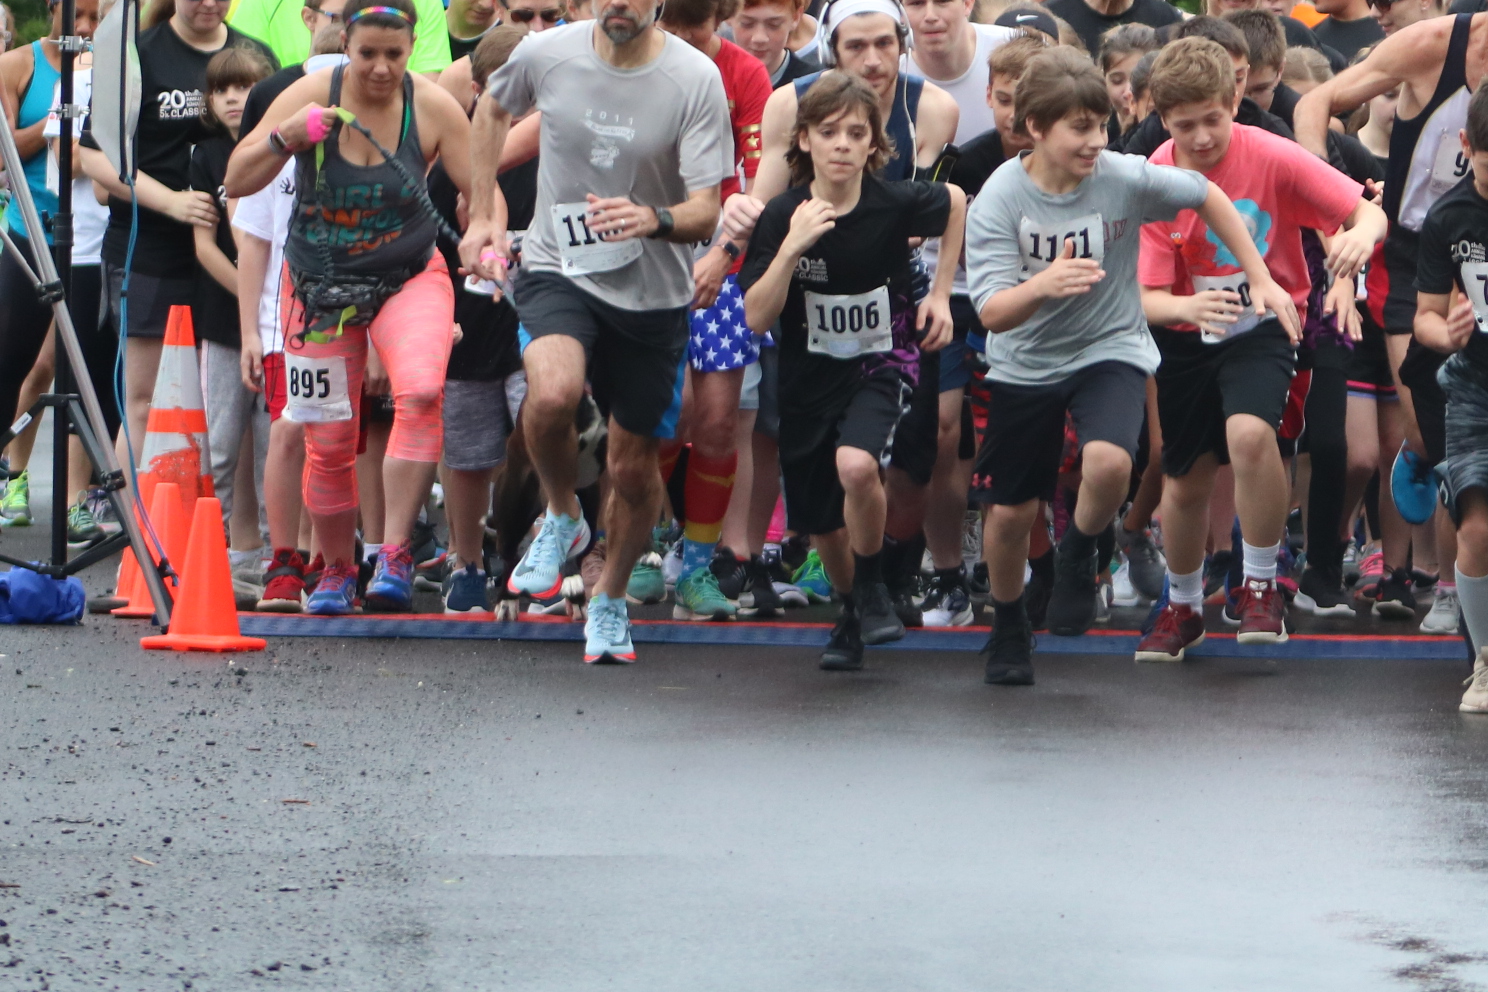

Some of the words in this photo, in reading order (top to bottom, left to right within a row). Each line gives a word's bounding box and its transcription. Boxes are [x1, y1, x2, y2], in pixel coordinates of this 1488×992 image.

[157, 89, 186, 109] 20
[815, 300, 880, 333] 1006
[290, 365, 331, 398] 895
